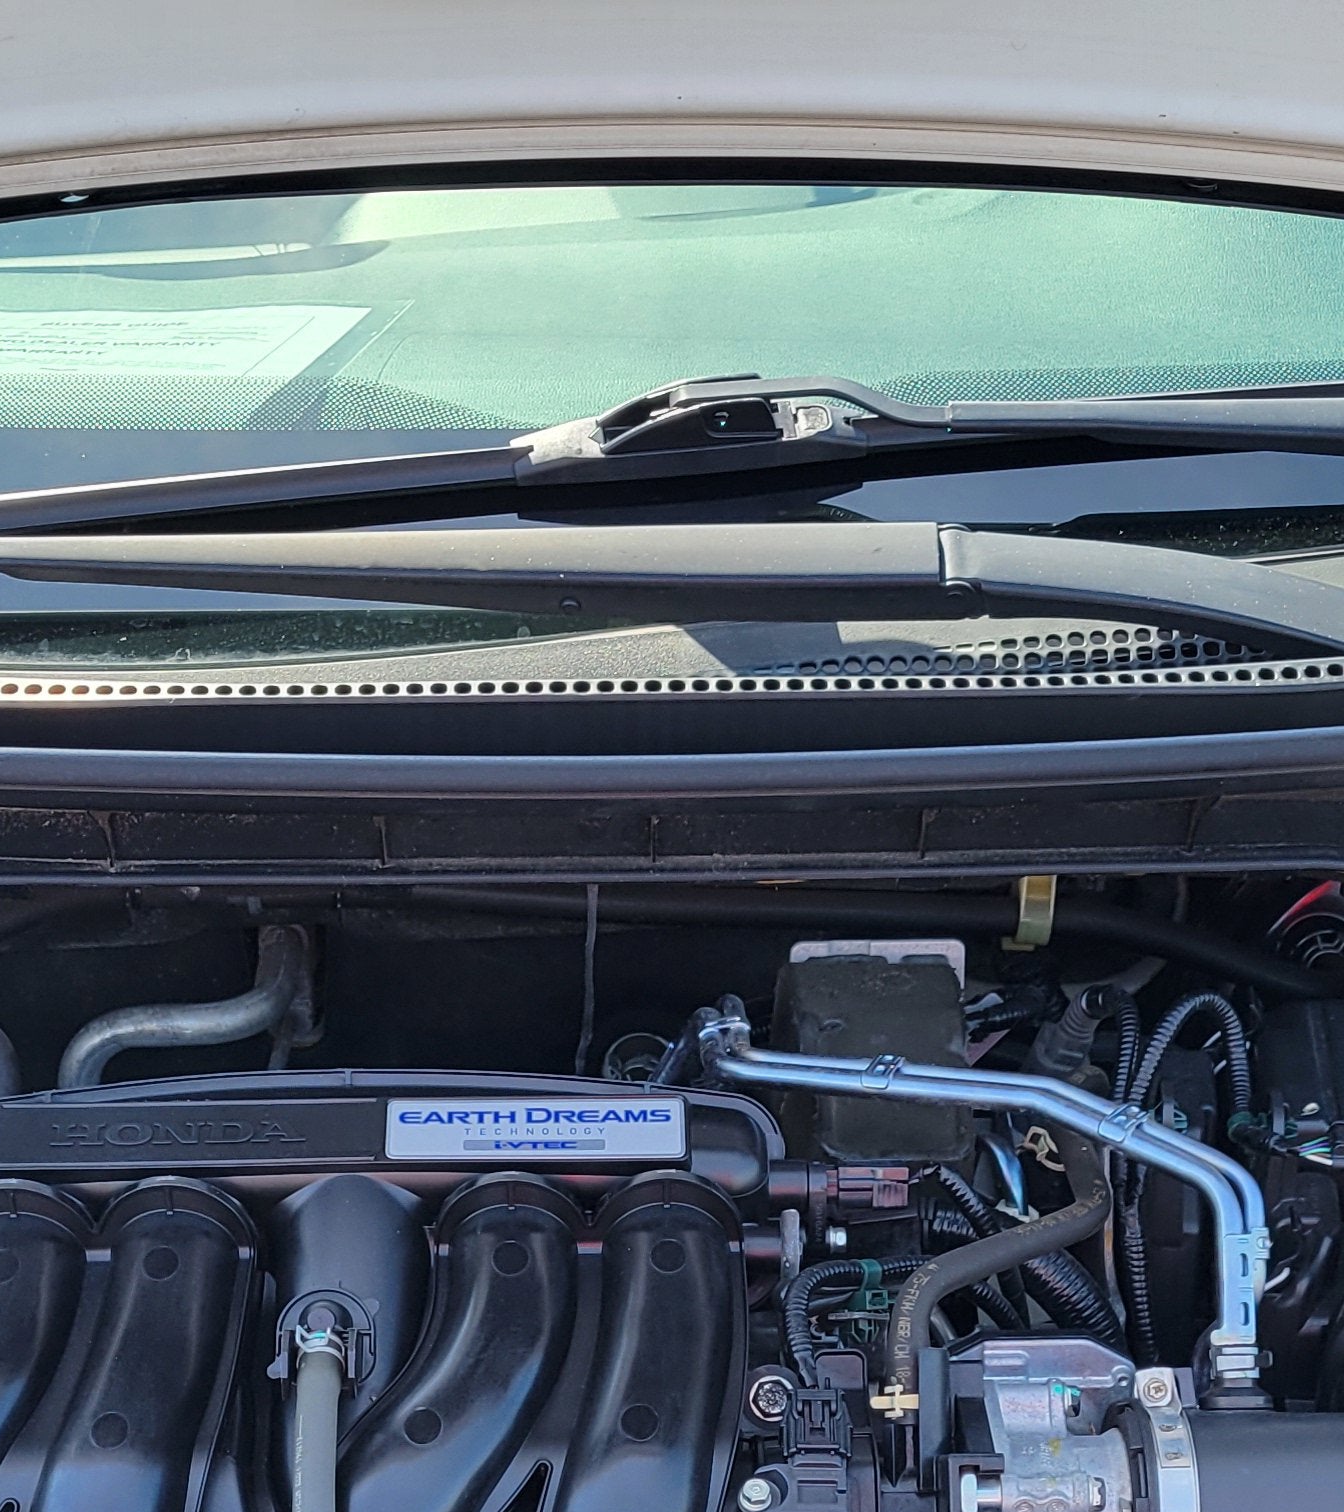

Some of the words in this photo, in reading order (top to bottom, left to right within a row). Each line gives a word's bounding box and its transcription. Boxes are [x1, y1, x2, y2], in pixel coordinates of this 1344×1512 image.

[398, 1109, 518, 1125] EARTH
[524, 1107, 672, 1124] DREAMS
[50, 1119, 308, 1148] HONDA
[464, 1127, 606, 1136] TECHNOLOGY
